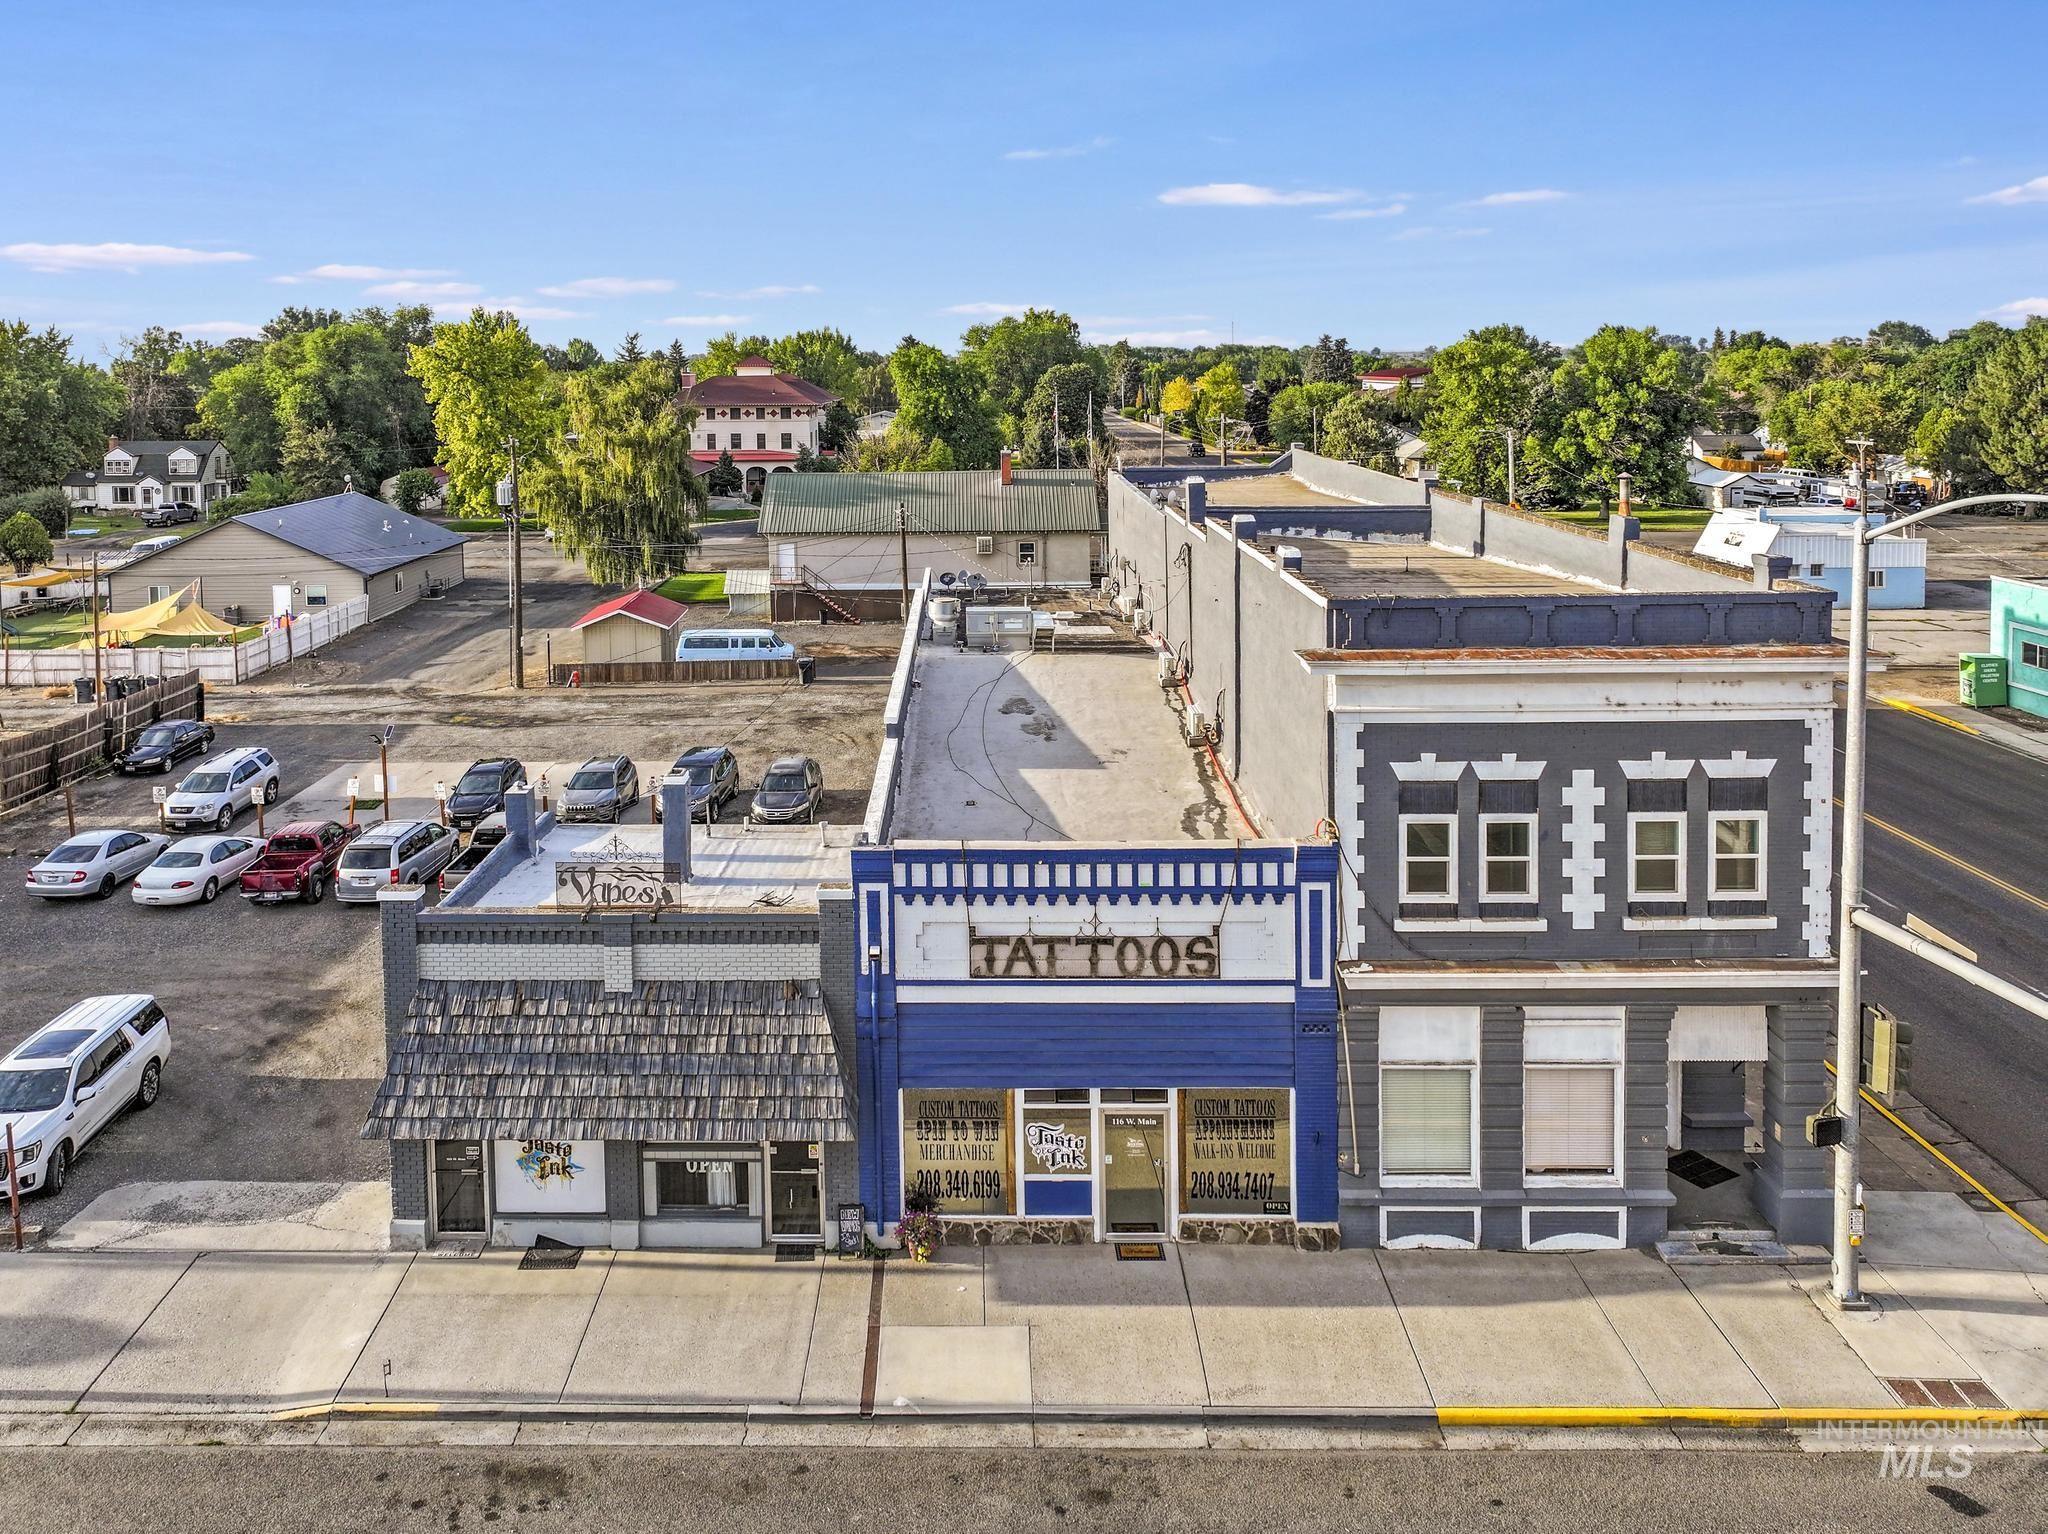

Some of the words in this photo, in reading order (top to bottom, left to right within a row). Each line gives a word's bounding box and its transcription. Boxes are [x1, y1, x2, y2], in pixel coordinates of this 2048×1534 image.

[558, 866, 655, 909] Vapes
[971, 936, 1217, 978] TATTOOS
[918, 1100, 954, 1117] CUSTOM
[959, 1100, 999, 1117] TATTOOS
[1194, 1098, 1230, 1116] CUSTOM
[1234, 1098, 1277, 1116] TATTOOS
[916, 1120, 947, 1141] SPIN
[952, 1120, 968, 1141] TO
[972, 1120, 1000, 1141] WIN
[1137, 1118, 1157, 1126] Main
[1195, 1119, 1275, 1141] APPOINTMENTS
[1027, 1124, 1085, 1150] Taste
[919, 1143, 995, 1161] MERCHANDISE
[1047, 1148, 1085, 1167] Ink
[1193, 1142, 1234, 1160] WALK-INS
[1237, 1142, 1277, 1160] WELCOME
[536, 1155, 575, 1181] Ink
[686, 1161, 733, 1173] OPEN
[916, 1169, 1001, 1199] 208.340.6199
[1190, 1171, 1276, 1200] 208.934.7407
[1266, 1202, 1289, 1210] OPEN
